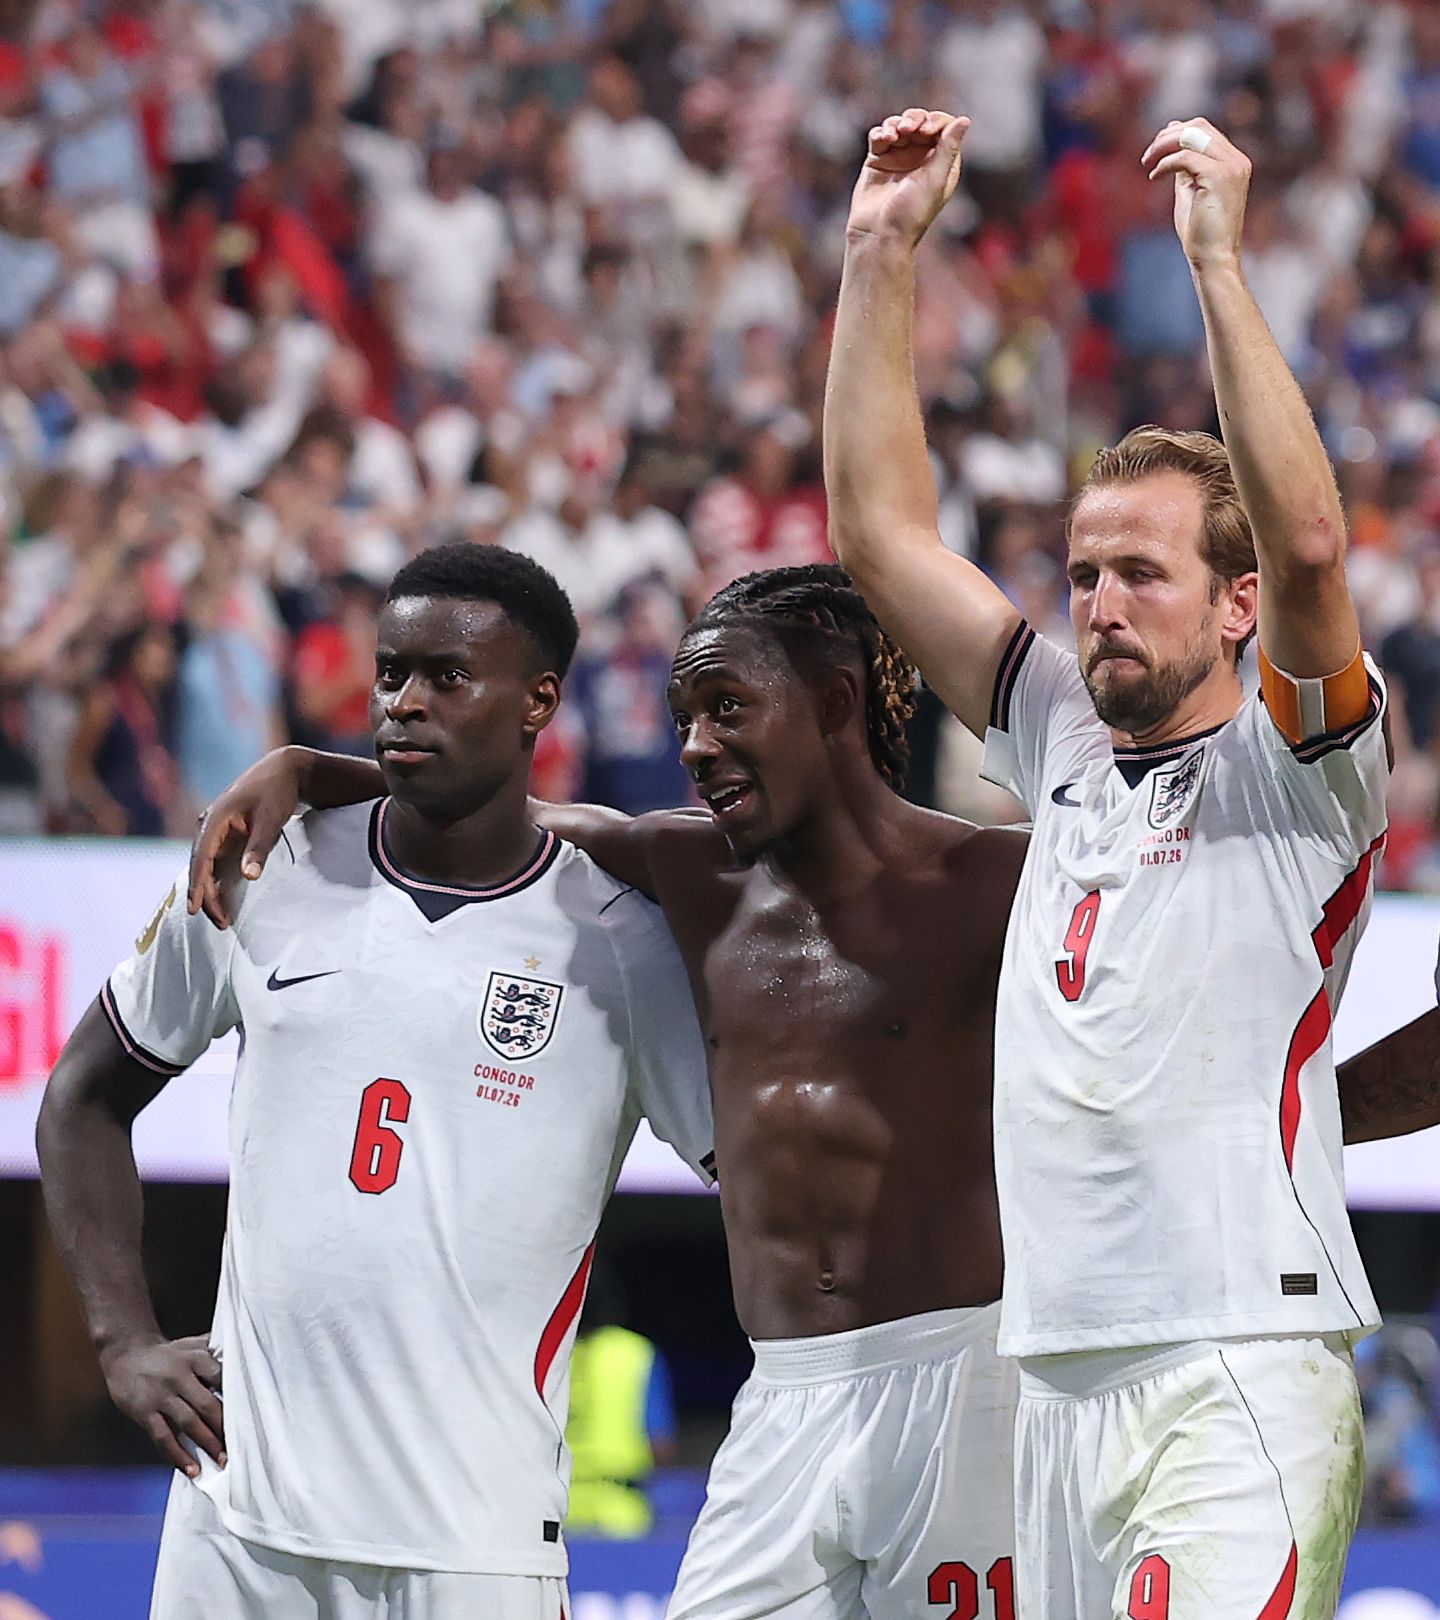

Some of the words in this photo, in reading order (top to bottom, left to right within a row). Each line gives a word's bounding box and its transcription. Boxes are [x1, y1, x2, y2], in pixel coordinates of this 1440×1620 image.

[1175, 826, 1191, 842] DR
[1139, 848, 1182, 866] 01.07.26
[1055, 888, 1101, 1002] 9
[473, 1063, 517, 1086] CONGO
[517, 1074, 535, 1090] DR
[475, 1084, 521, 1107] 01.07.26
[348, 1077, 412, 1195] 6
